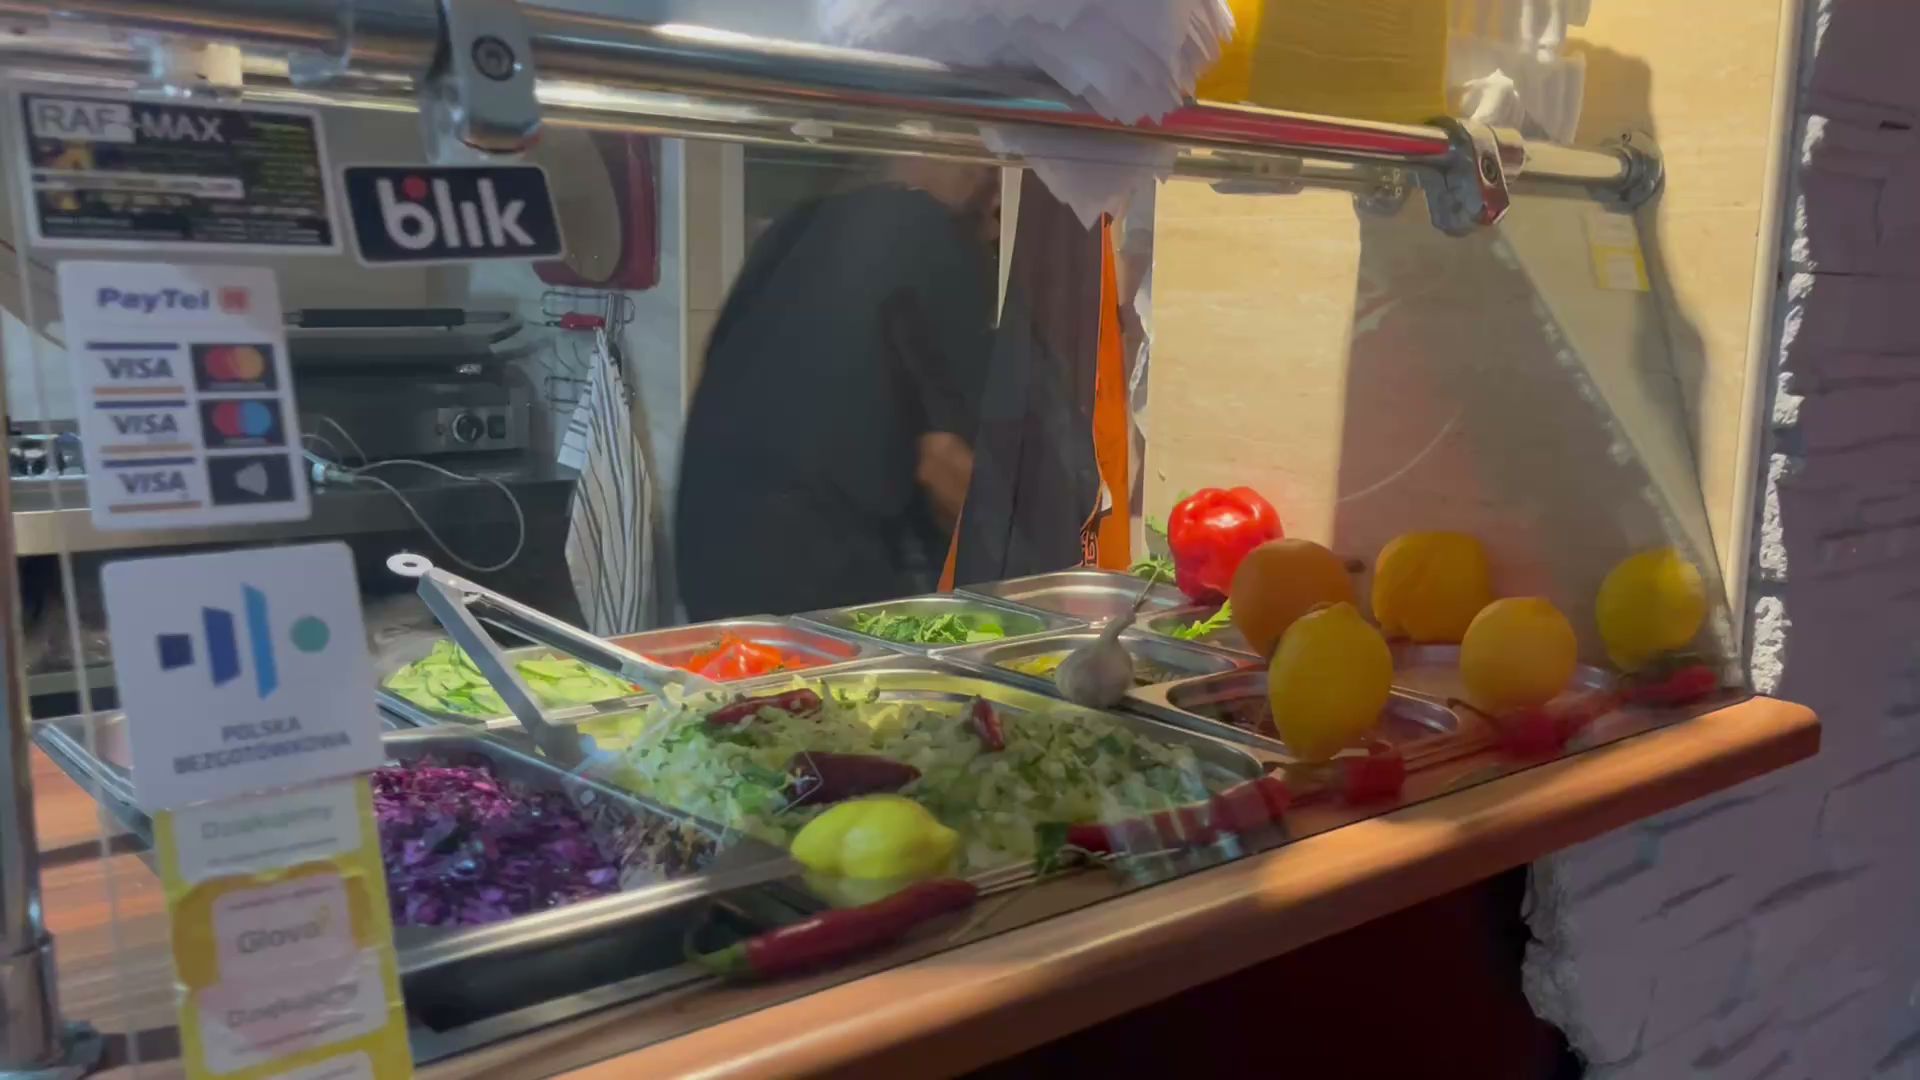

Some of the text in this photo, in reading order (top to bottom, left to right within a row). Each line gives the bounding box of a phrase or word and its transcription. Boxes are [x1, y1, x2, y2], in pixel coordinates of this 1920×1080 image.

[376, 176, 536, 250] blik
[97, 287, 210, 314] PayTel
[102, 357, 174, 380] VISA
[112, 413, 178, 435] VISA
[118, 470, 188, 494] VISA
[221, 716, 302, 742] POLSKA
